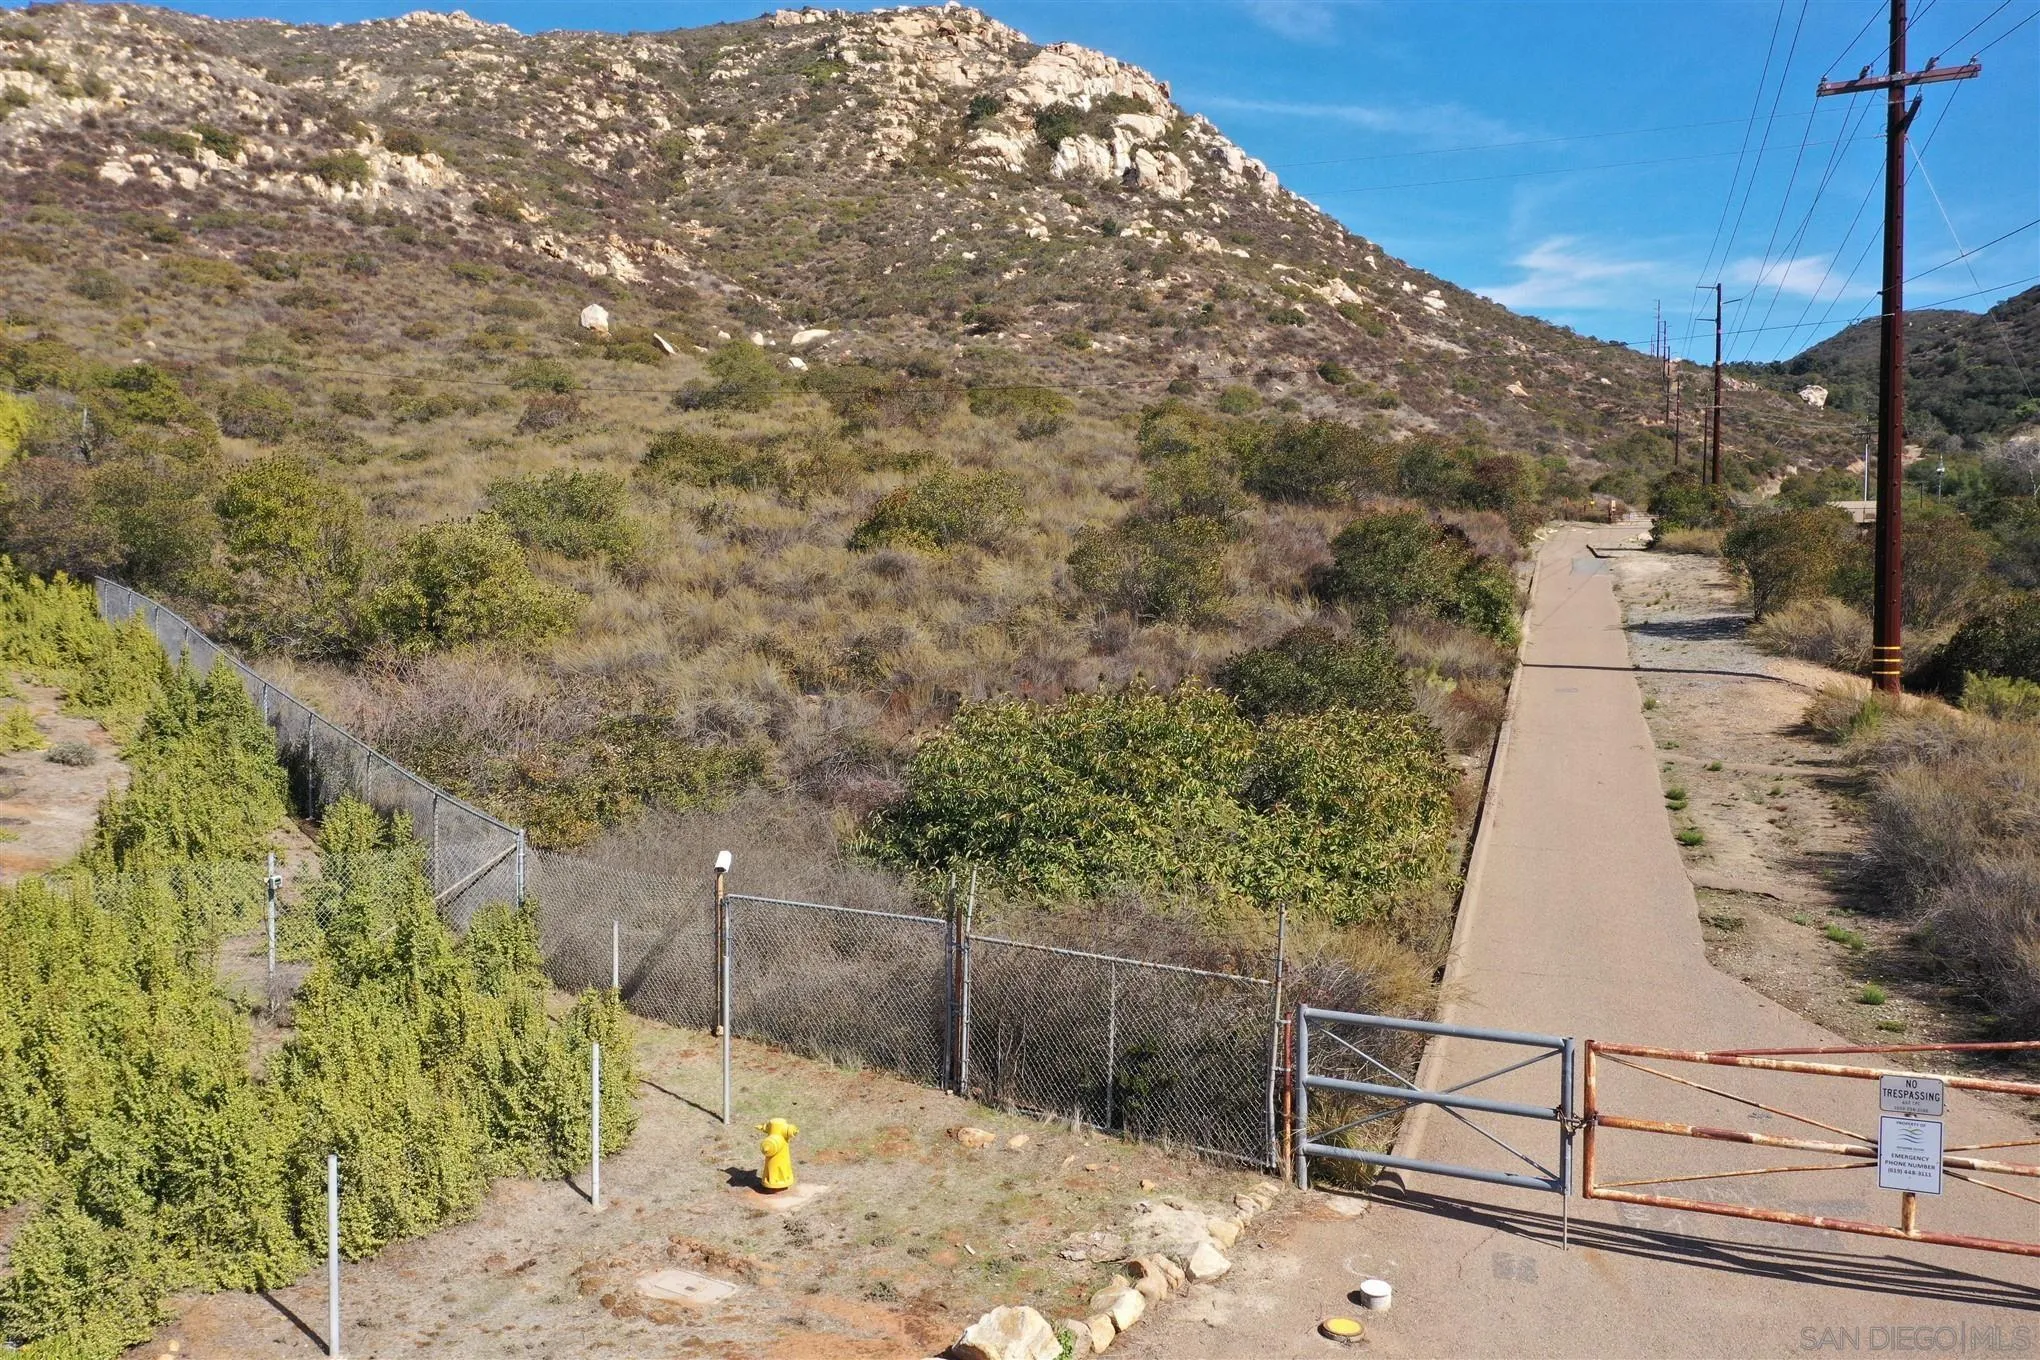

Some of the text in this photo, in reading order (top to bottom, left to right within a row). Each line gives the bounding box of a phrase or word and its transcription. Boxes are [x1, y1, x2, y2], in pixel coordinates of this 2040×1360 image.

[1906, 1080, 1918, 1088] NO
[1882, 1088, 1940, 1102] TRESPASSING
[1891, 1153, 1930, 1161] EMERGENCY
[1908, 1162, 1935, 1170] NUMBER
